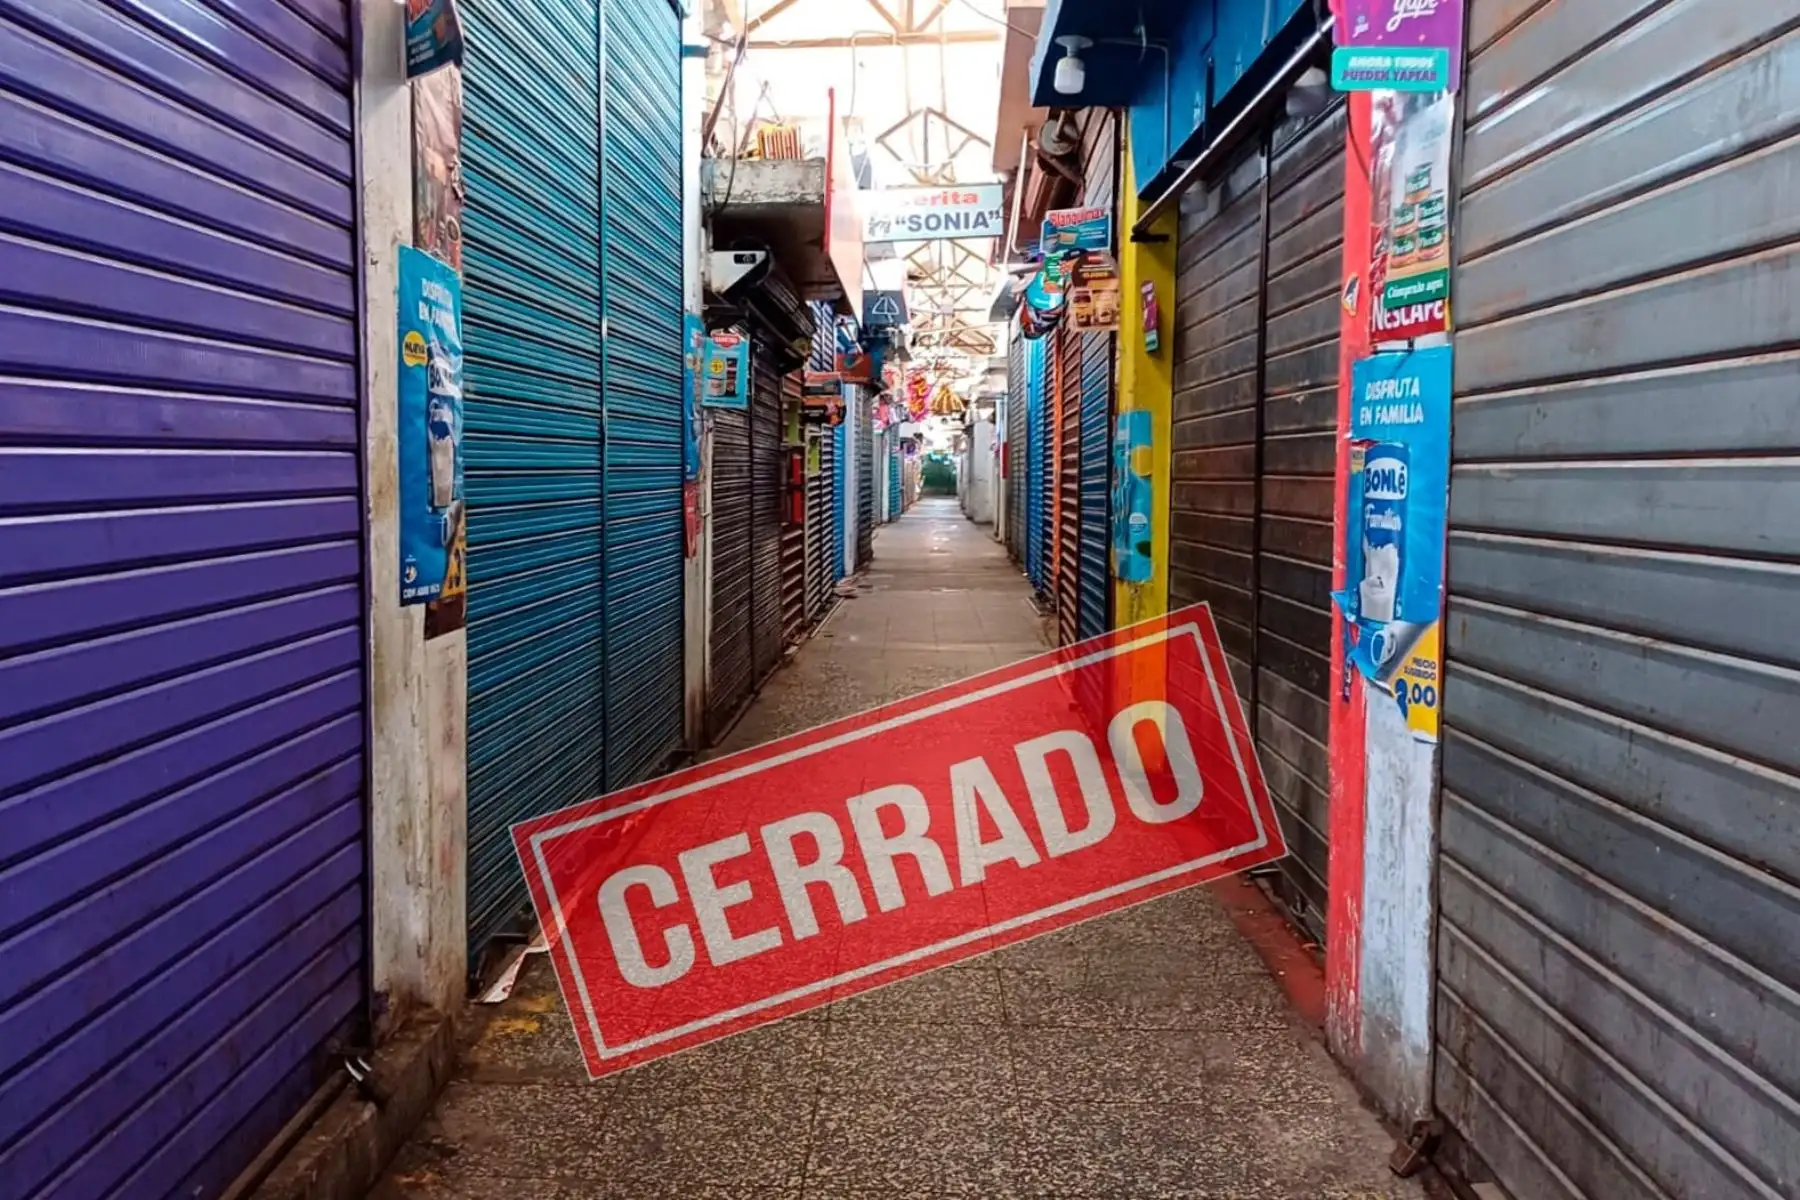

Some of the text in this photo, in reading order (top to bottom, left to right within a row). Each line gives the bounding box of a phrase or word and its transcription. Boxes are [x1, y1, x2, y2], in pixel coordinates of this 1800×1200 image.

[1342, 69, 1389, 82] PUEDEN
[1364, 376, 1420, 401] DISFRUTA
[1359, 402, 1425, 427] EN FAMILIA
